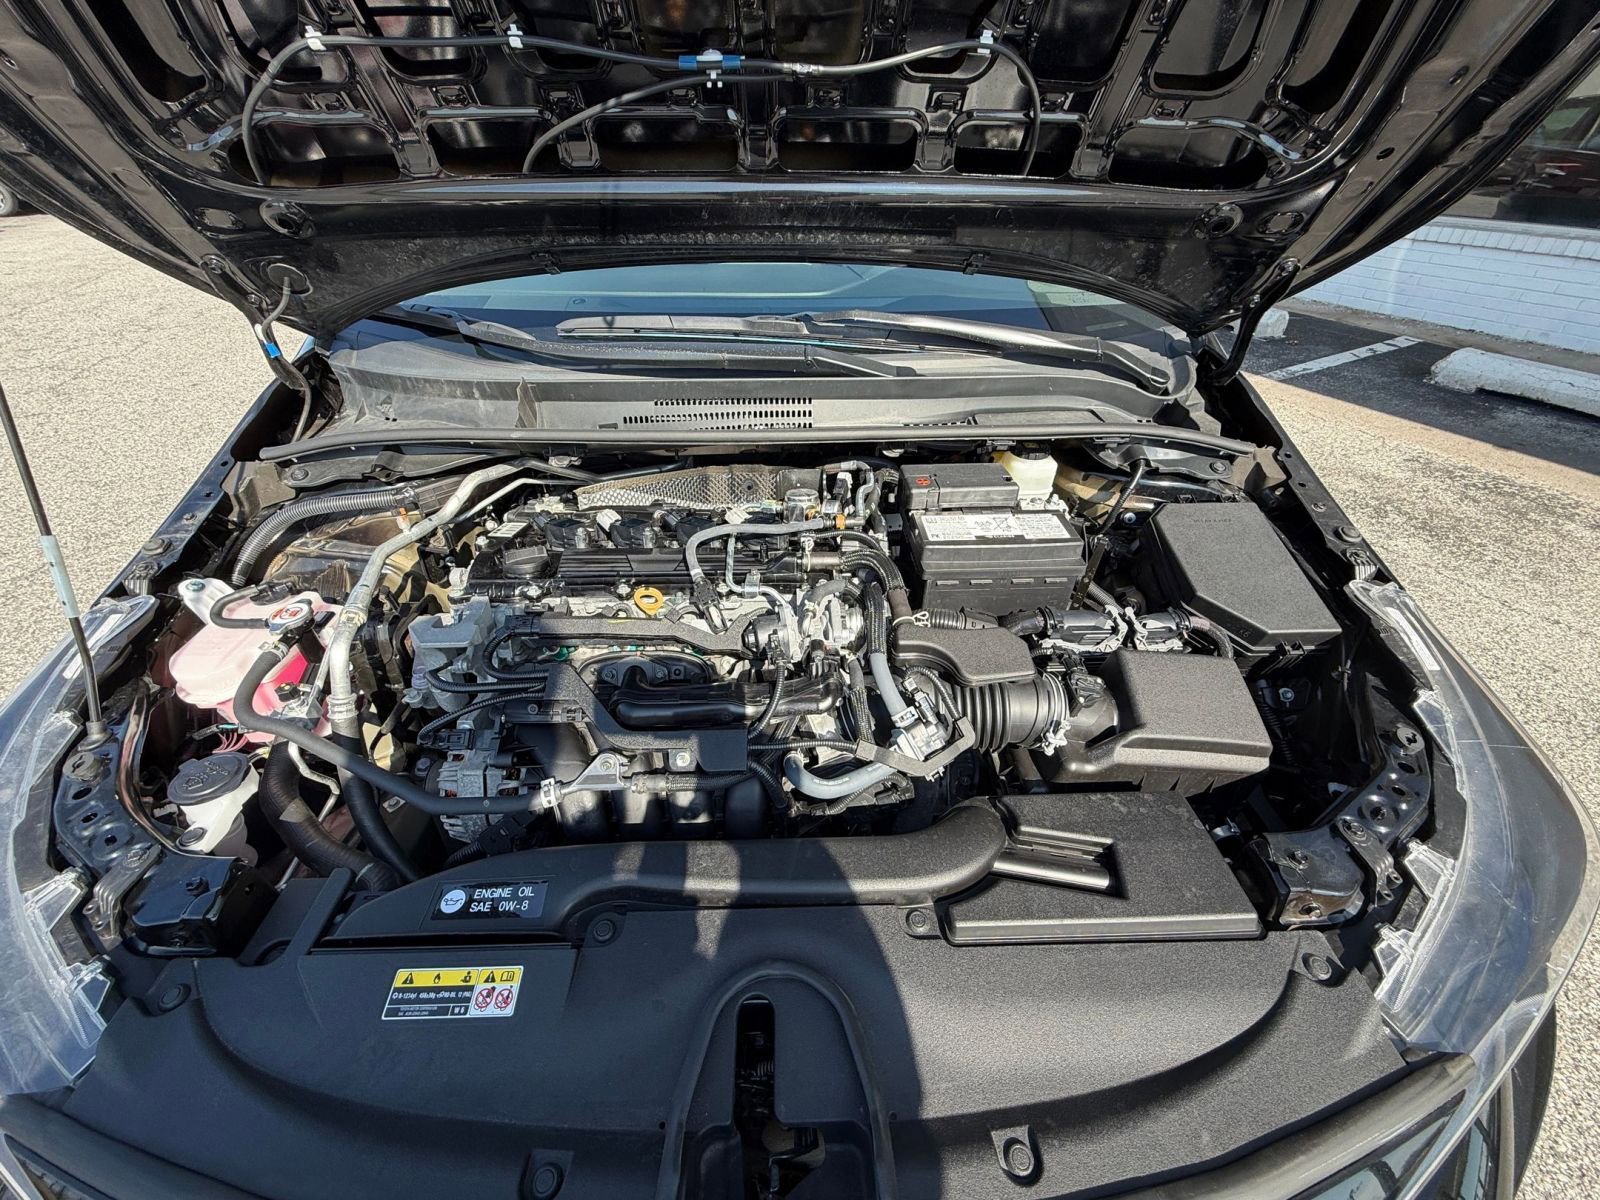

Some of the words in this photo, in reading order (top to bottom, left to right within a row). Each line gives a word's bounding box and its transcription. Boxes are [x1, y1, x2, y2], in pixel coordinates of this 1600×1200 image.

[473, 887, 513, 899] ENGINE
[518, 886, 535, 897] OIL
[469, 901, 492, 912] SAE
[498, 900, 529, 911] 0W-8
